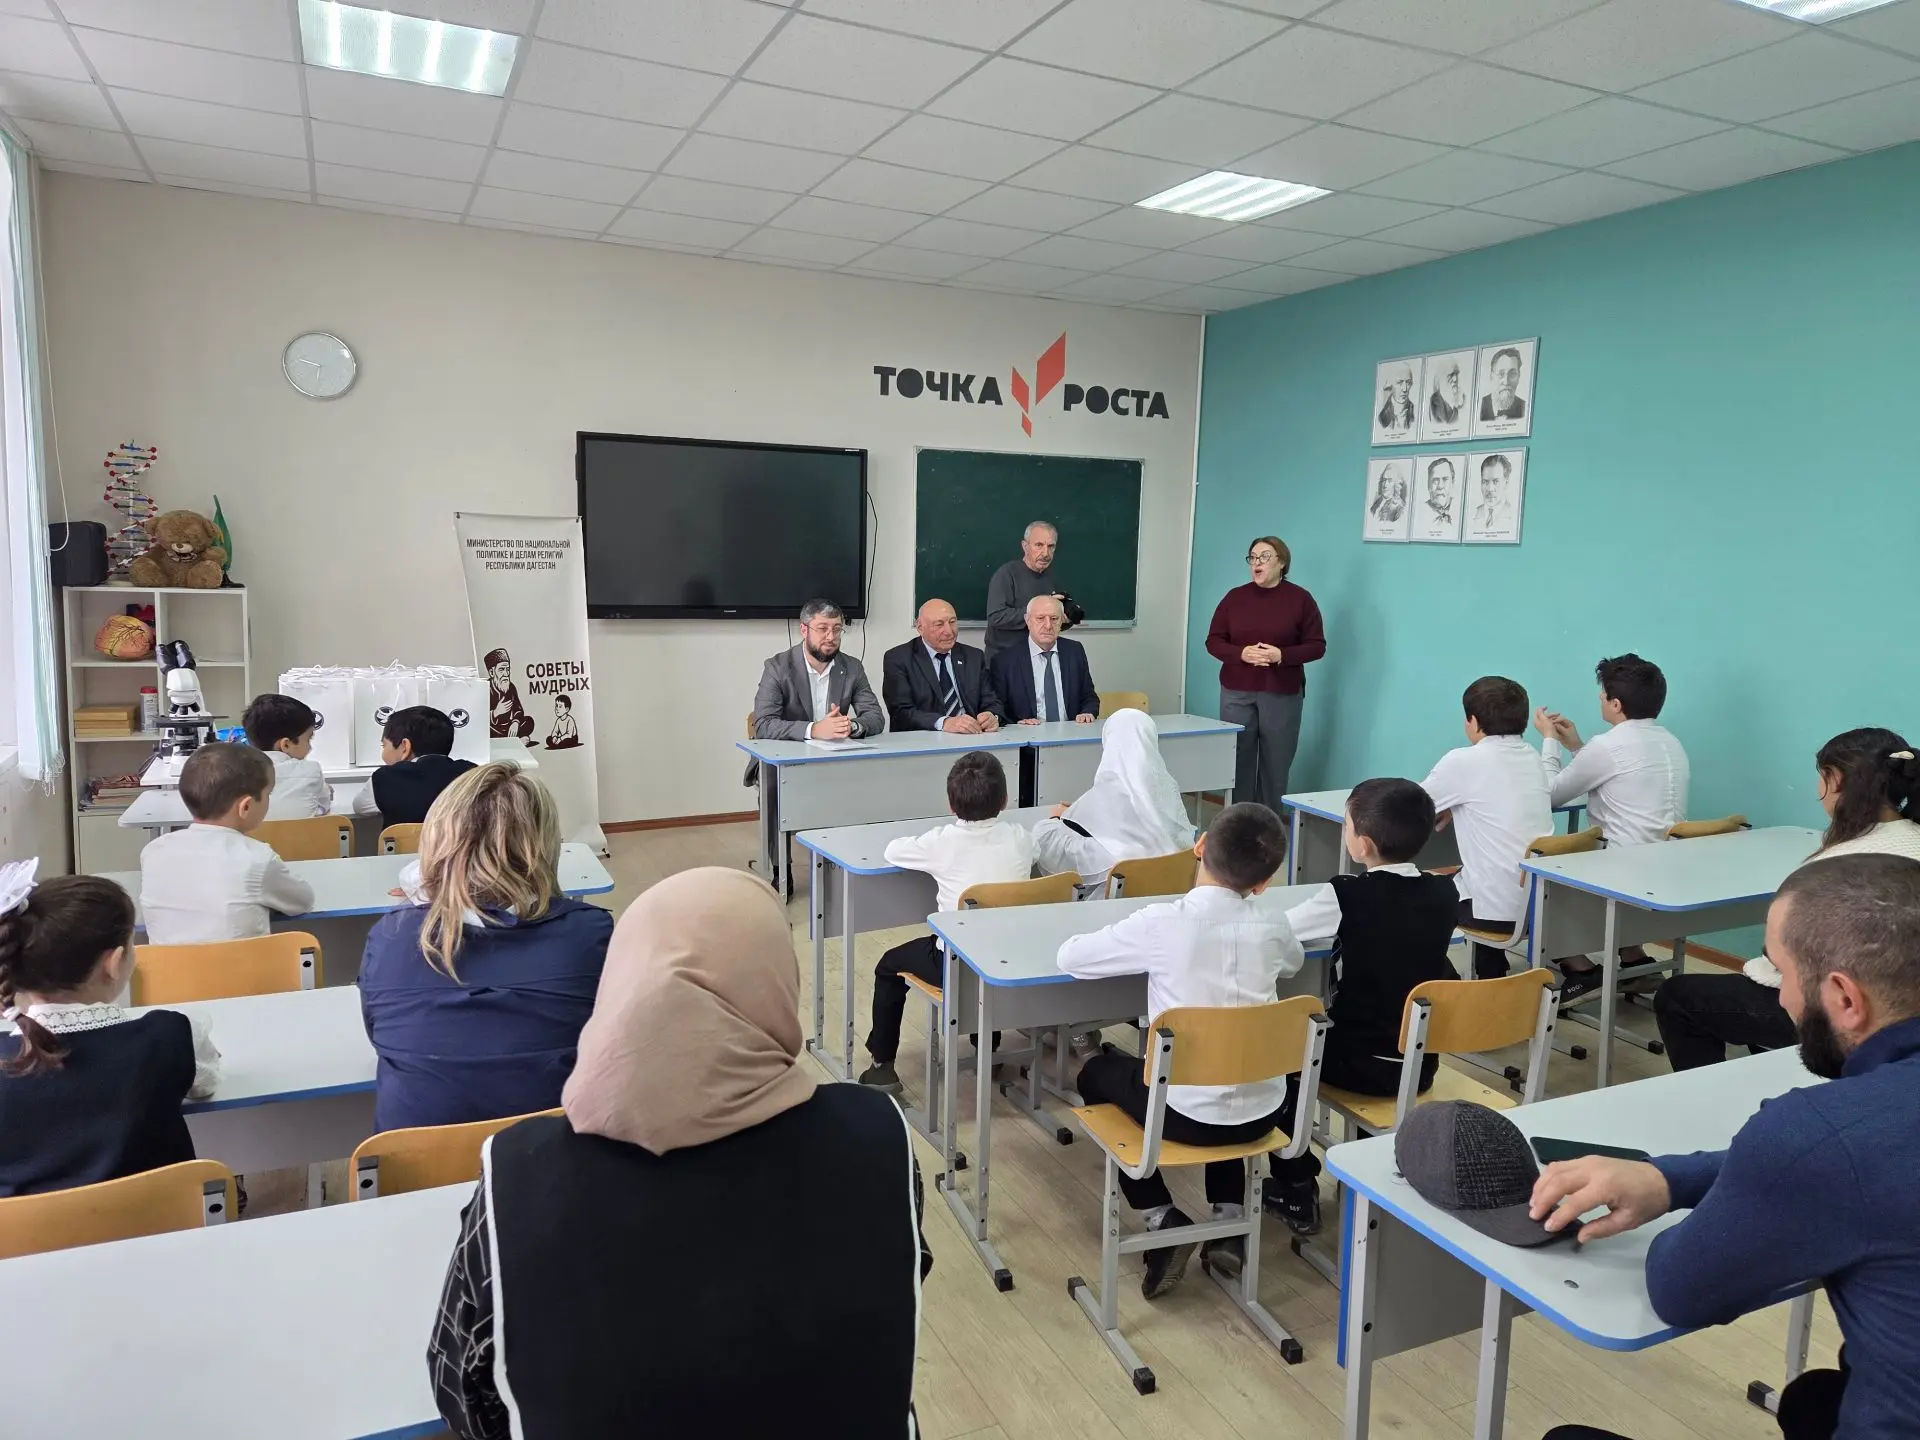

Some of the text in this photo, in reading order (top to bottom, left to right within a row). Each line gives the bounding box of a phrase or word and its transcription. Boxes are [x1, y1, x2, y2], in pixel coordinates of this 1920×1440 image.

[873, 365, 1170, 419] ТОЧКА РОСТА
[466, 539, 571, 549] МИНИСТЕРСТВО ПО НАЦИОНАЛЬНОЙ
[476, 550, 564, 560] ПОЛИТИКЕ И ДЕЛАМ РЕЛИГИЙ
[486, 561, 556, 571] РЕСПУБЛИКИ ДАГЕСТАН
[526, 660, 585, 679] СОВЕТЫ
[529, 677, 590, 695] МУДРЫХ
